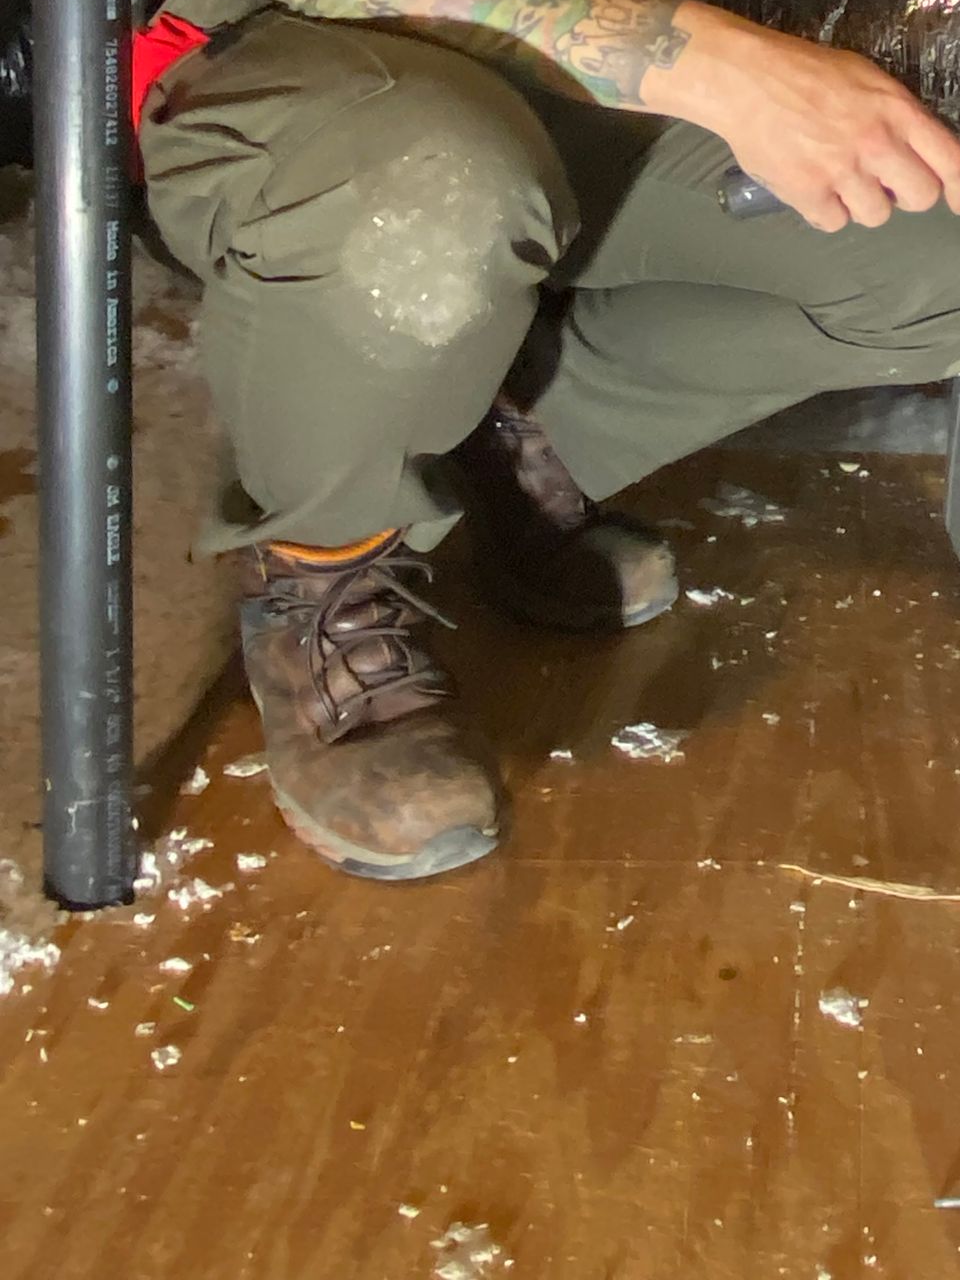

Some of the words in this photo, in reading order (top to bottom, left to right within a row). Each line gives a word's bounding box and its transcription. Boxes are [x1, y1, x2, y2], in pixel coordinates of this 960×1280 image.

[103, 37, 118, 146] 754826027412
[105, 219, 119, 261] Made
[105, 270, 121, 291] in
[105, 296, 119, 367] America
[105, 513, 119, 566] EAGLE
